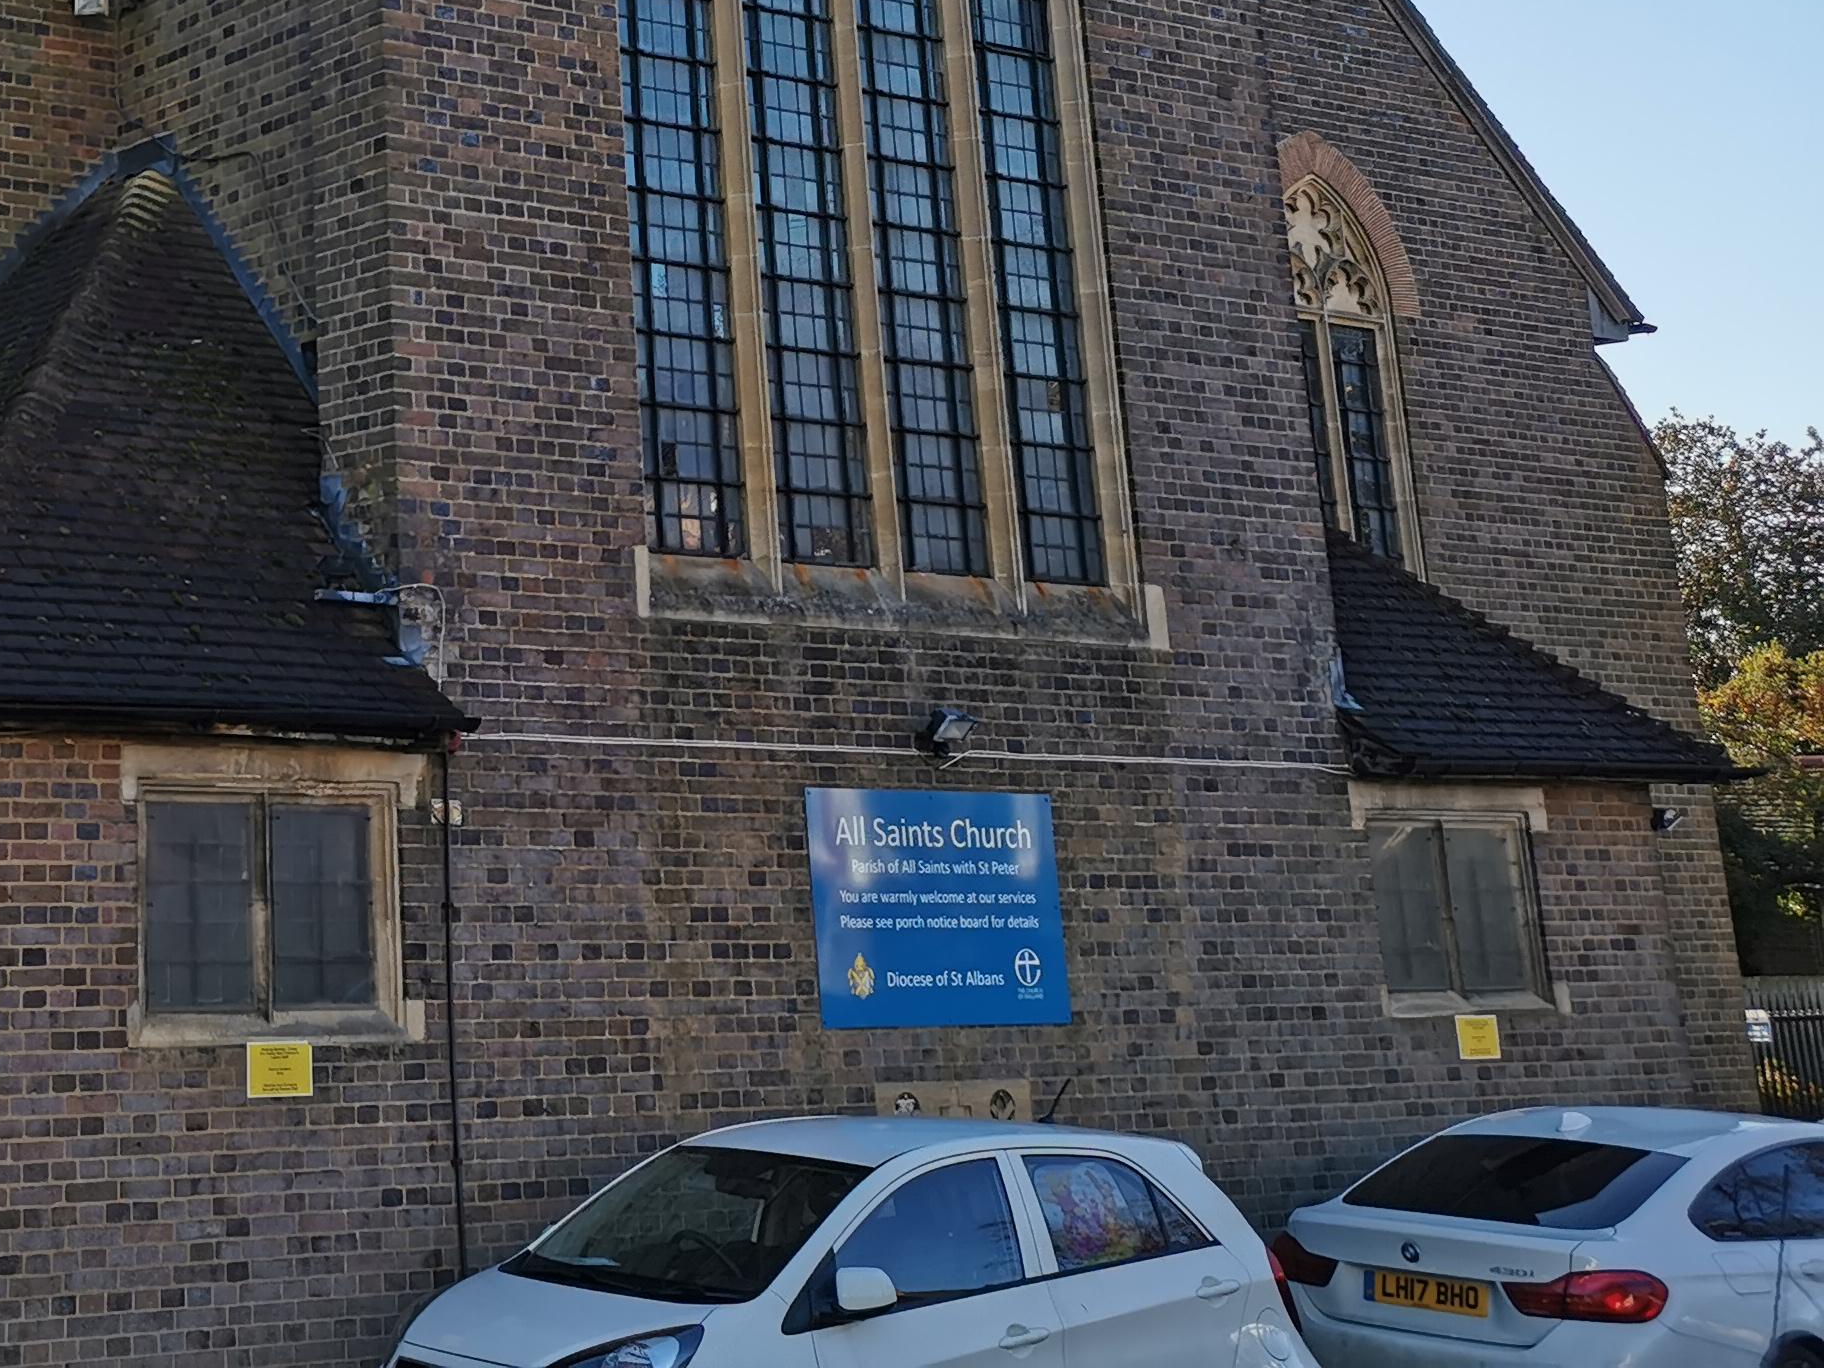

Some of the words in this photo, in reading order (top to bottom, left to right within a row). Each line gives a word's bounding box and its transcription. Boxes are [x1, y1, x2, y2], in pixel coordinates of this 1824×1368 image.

[835, 815, 866, 846] All
[872, 817, 945, 848] Saints
[950, 818, 1032, 849] Church
[851, 858, 885, 873] Parish
[887, 858, 900, 873] of
[902, 859, 917, 874] All
[918, 860, 951, 874] Saints
[952, 860, 977, 875] with
[978, 861, 989, 875] St
[991, 861, 1020, 875] Peter
[839, 890, 859, 903] You
[861, 892, 878, 903] are
[880, 890, 917, 906] warmly
[919, 890, 965, 904] welcome
[966, 892, 978, 904] at
[978, 894, 996, 904] our
[998, 892, 1037, 904] services
[840, 915, 874, 928] Please
[876, 918, 893, 928] see
[895, 915, 925, 931] porch
[927, 915, 958, 928] notice
[960, 915, 989, 929] board
[991, 915, 1005, 928] for
[1007, 915, 1040, 929] details
[887, 971, 934, 987] Diocese
[936, 970, 949, 986] of
[950, 971, 963, 986] St
[965, 971, 1005, 986] Albans
[1382, 1274, 1428, 1301] LH17
